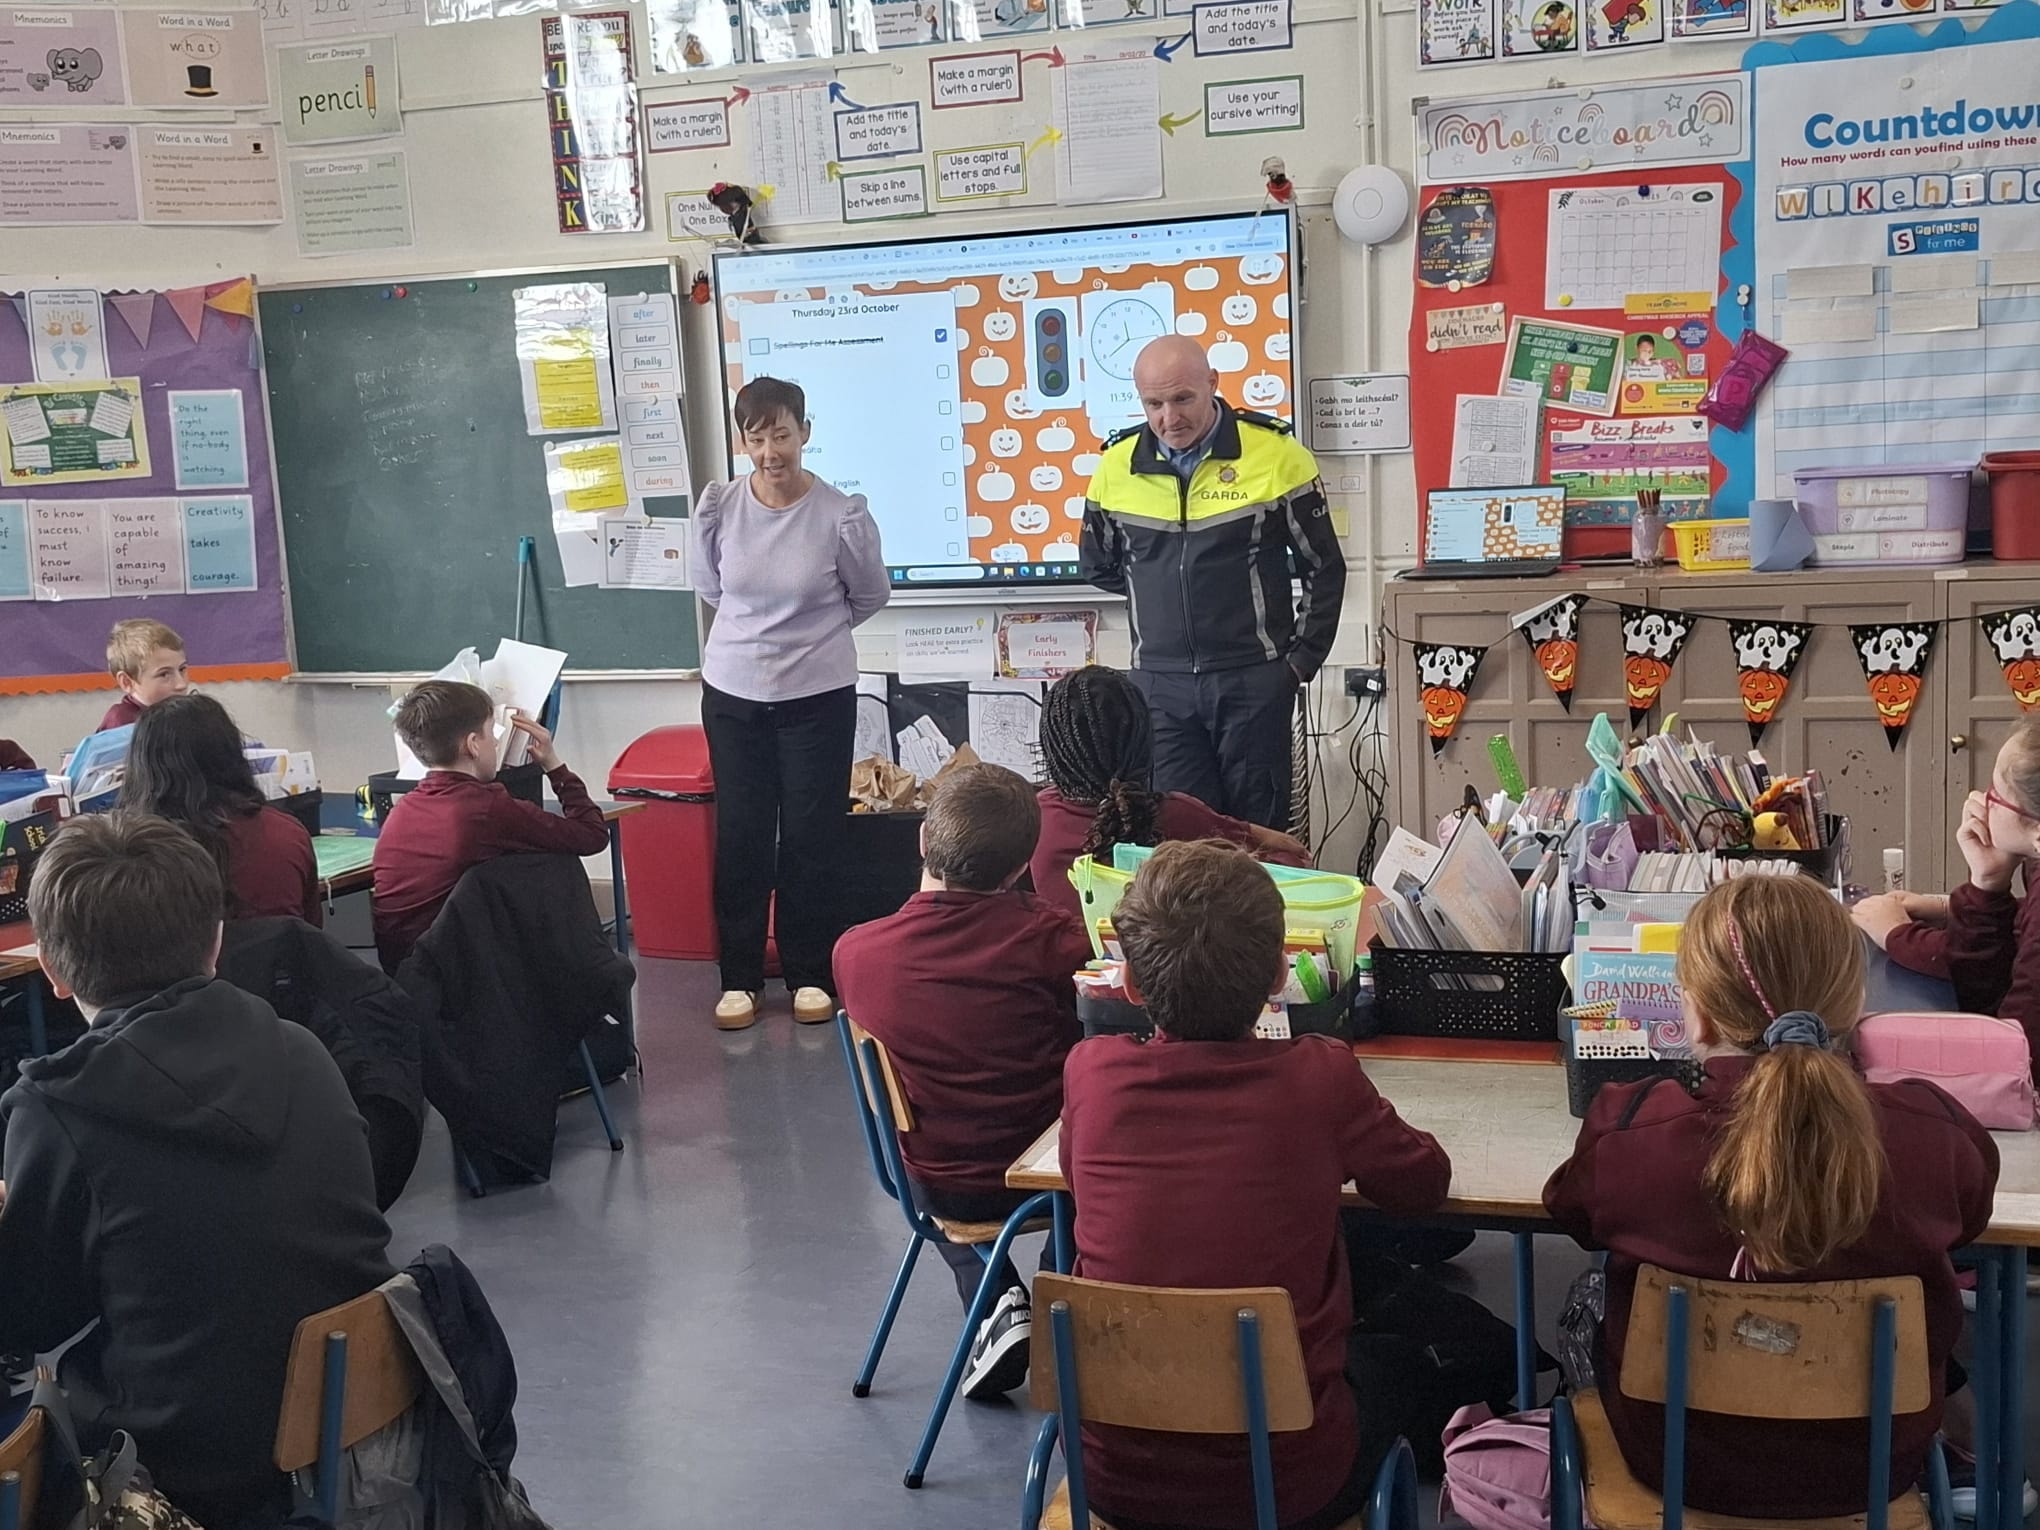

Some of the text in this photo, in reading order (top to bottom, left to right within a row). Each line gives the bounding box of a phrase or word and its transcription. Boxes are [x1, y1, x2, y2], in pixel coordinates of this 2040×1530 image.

[1205, 4, 1278, 19] Add the title
[14, 14, 68, 24] Mnemonics
[159, 15, 184, 26] Word
[187, 18, 195, 26] in
[205, 17, 230, 27] Word
[1208, 18, 1276, 34] and today's
[1228, 37, 1258, 47] date.
[331, 48, 366, 59] Drawings
[938, 65, 1014, 81] Make a margin
[940, 84, 968, 96] (with
[1228, 91, 1280, 104] Use your
[653, 112, 723, 127] Make a margin
[846, 110, 909, 126] Add the title
[1211, 108, 1252, 120] cursive
[656, 128, 681, 141] (with
[684, 130, 690, 138] a
[849, 125, 907, 140] and today's
[1462, 104, 1706, 155] Noticeboard
[1, 131, 55, 142] Mnemonics
[155, 133, 180, 143] Word
[203, 134, 228, 145] Word
[867, 142, 892, 152] date.
[1781, 134, 2037, 167] How many words can using these
[950, 150, 1009, 166] Use capital
[328, 162, 364, 173] Drawings
[940, 163, 1021, 182] letters and full
[860, 181, 881, 195] Skip
[965, 181, 998, 194] stops.
[847, 192, 922, 209] between sums.
[679, 202, 696, 213] One
[689, 215, 707, 226] One
[1944, 237, 1965, 248] me
[633, 308, 655, 319] after
[792, 304, 900, 318] Thursday 23rd October
[1473, 318, 1503, 334] read
[635, 333, 656, 343] later
[633, 357, 662, 368] finally
[640, 380, 660, 389] then
[193, 404, 208, 412] the
[1590, 420, 1675, 436] Bizz Breaks
[646, 431, 665, 440] next
[184, 465, 225, 476] watching
[646, 476, 673, 487] during
[833, 479, 861, 488] English
[1200, 490, 1249, 501] GARDA
[36, 508, 84, 519] To know
[112, 514, 155, 523] You are
[187, 507, 244, 520] Creativity
[38, 527, 82, 536] success,
[114, 527, 159, 542] capable
[39, 542, 69, 552] must
[115, 543, 128, 556] of
[190, 539, 220, 549] takes
[40, 556, 71, 568] know
[116, 561, 166, 573] amazing
[41, 572, 84, 585] failure.
[117, 575, 159, 589] things!
[192, 572, 239, 586] courage.
[905, 626, 974, 637] FINISHED EARLY?
[1034, 635, 1058, 645] Early
[1028, 648, 1067, 657] Finishers
[1584, 962, 1626, 979] David
[1584, 980, 1681, 1003] GRANDPA'S
